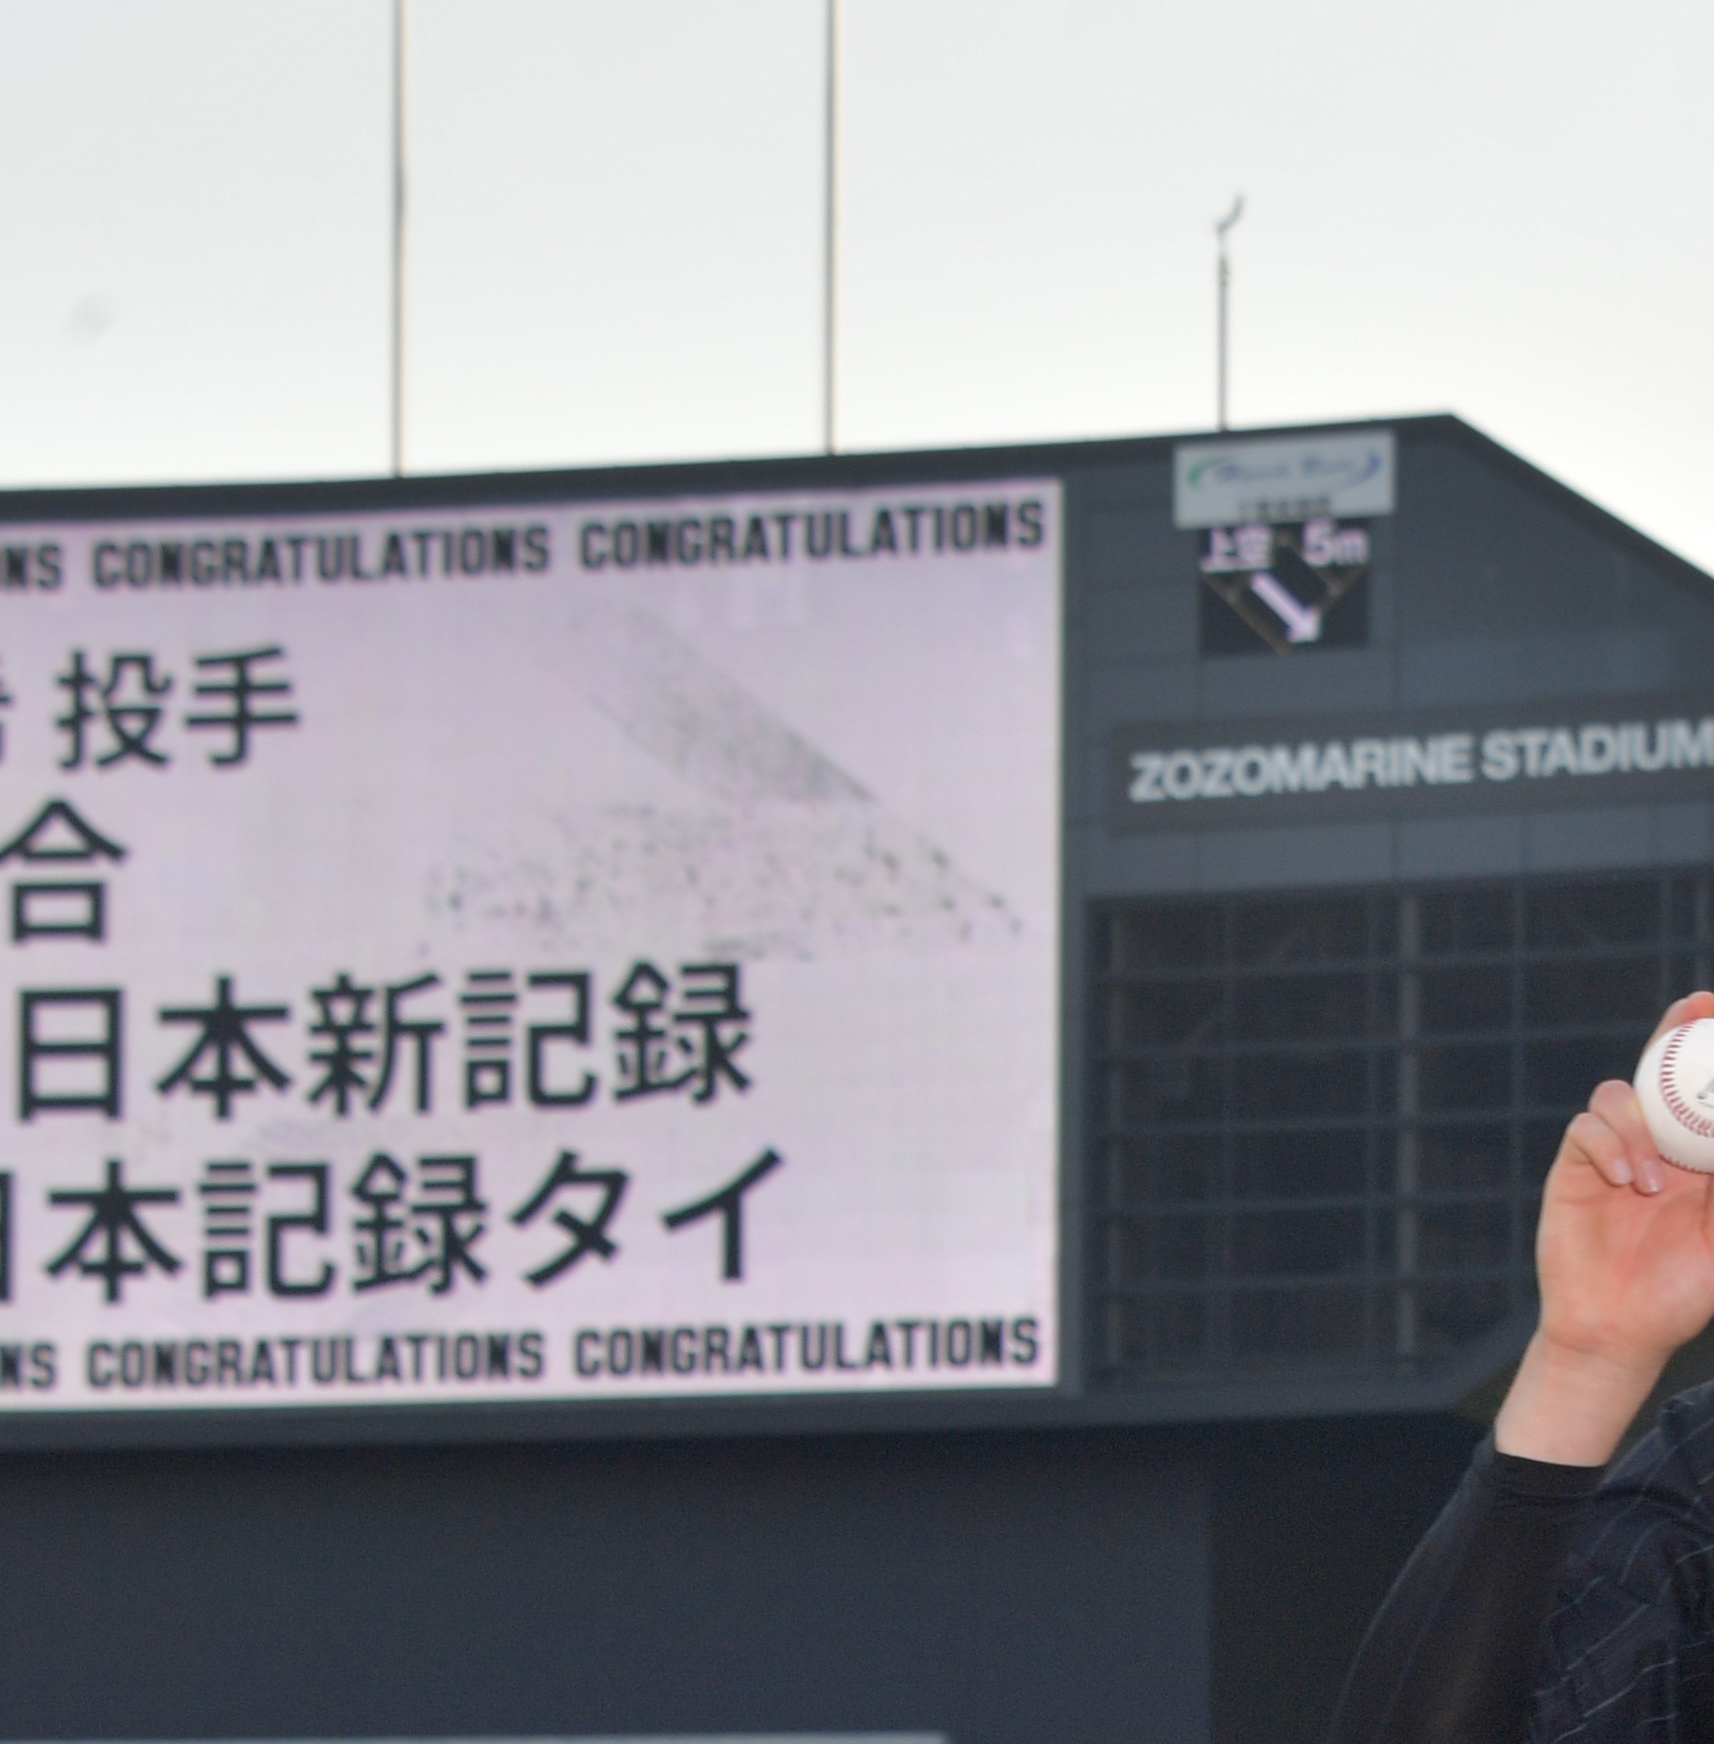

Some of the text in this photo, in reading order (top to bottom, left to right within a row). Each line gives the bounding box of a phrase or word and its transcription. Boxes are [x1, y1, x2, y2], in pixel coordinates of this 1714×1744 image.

[92, 524, 551, 591] CONGRATULATIONS
[578, 499, 1046, 572] CONGRATULATIONS
[55, 644, 300, 772] 投手
[1129, 732, 1474, 803] ZOZOMARINE
[85, 1329, 546, 1391] CONGRATULATIONS
[573, 1315, 1041, 1380] CONGRATULATIONS
